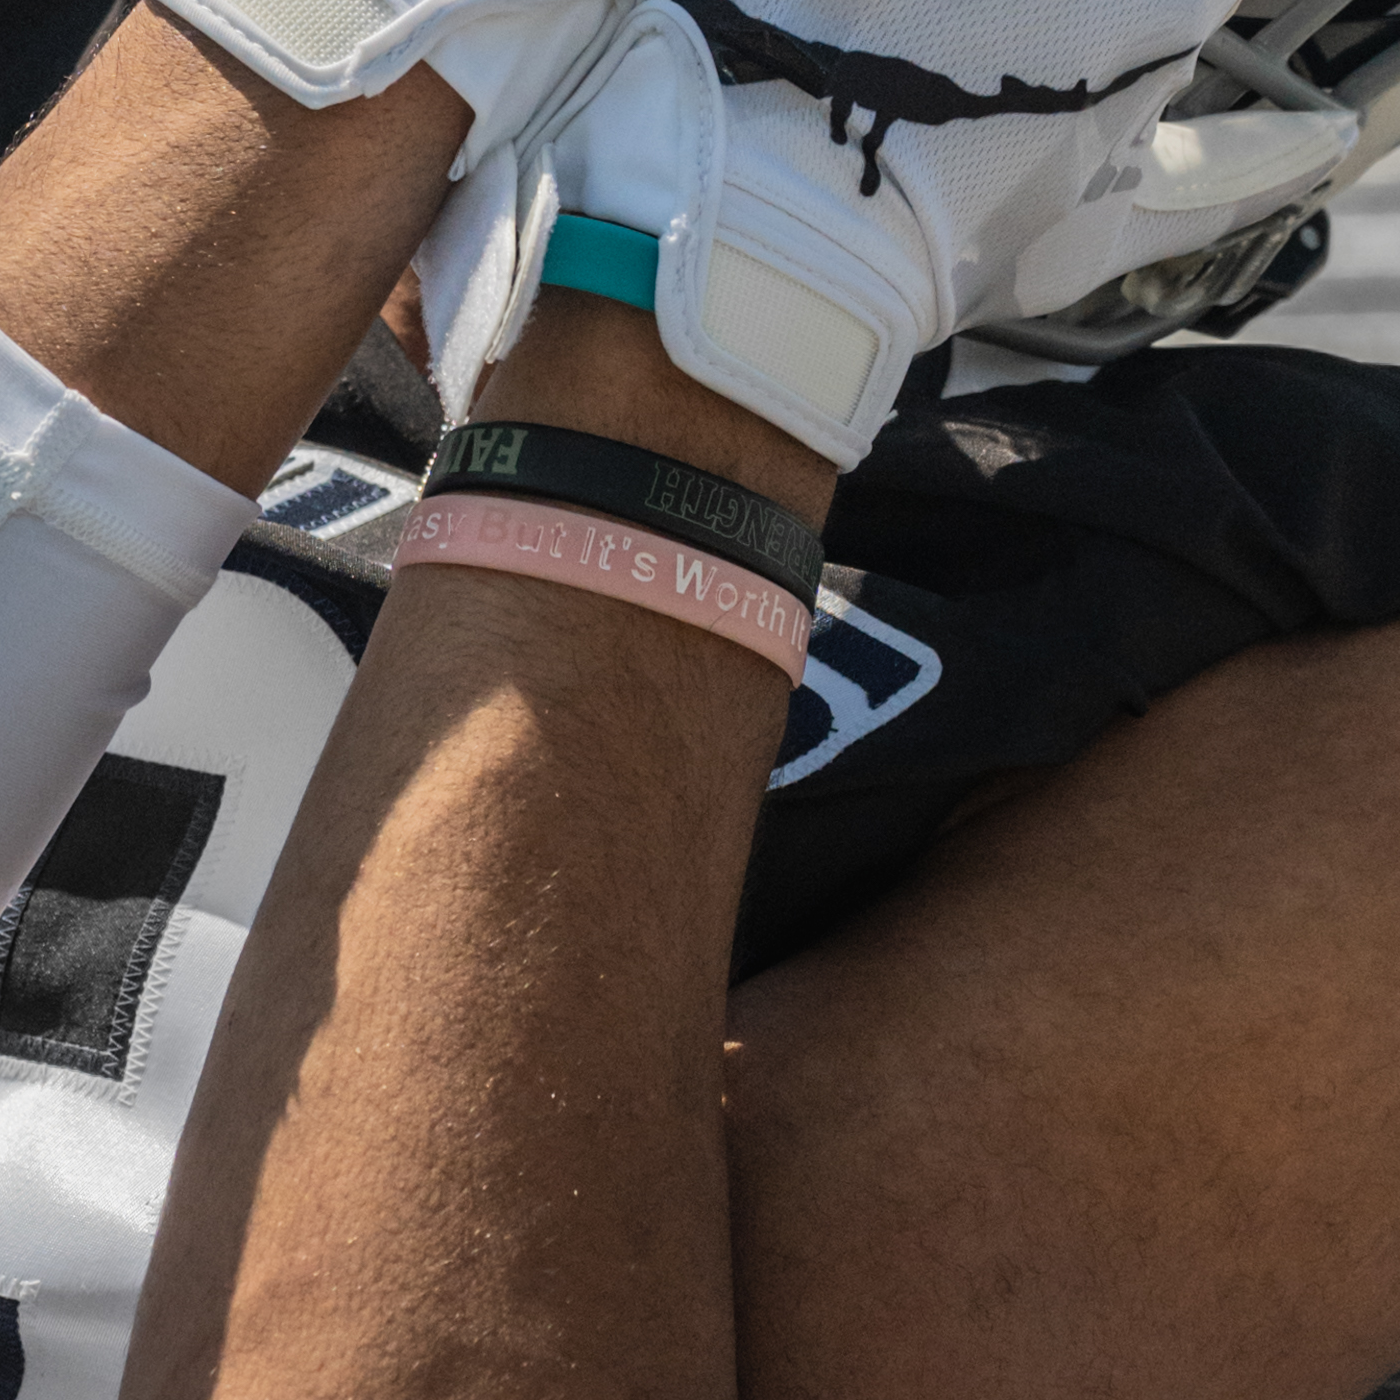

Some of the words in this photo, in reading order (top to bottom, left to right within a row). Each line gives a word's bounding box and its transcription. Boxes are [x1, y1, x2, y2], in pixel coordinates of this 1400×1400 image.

[401, 511, 467, 549] asy
[476, 505, 566, 559] But
[580, 526, 658, 583] It's
[675, 553, 787, 637] Worth
